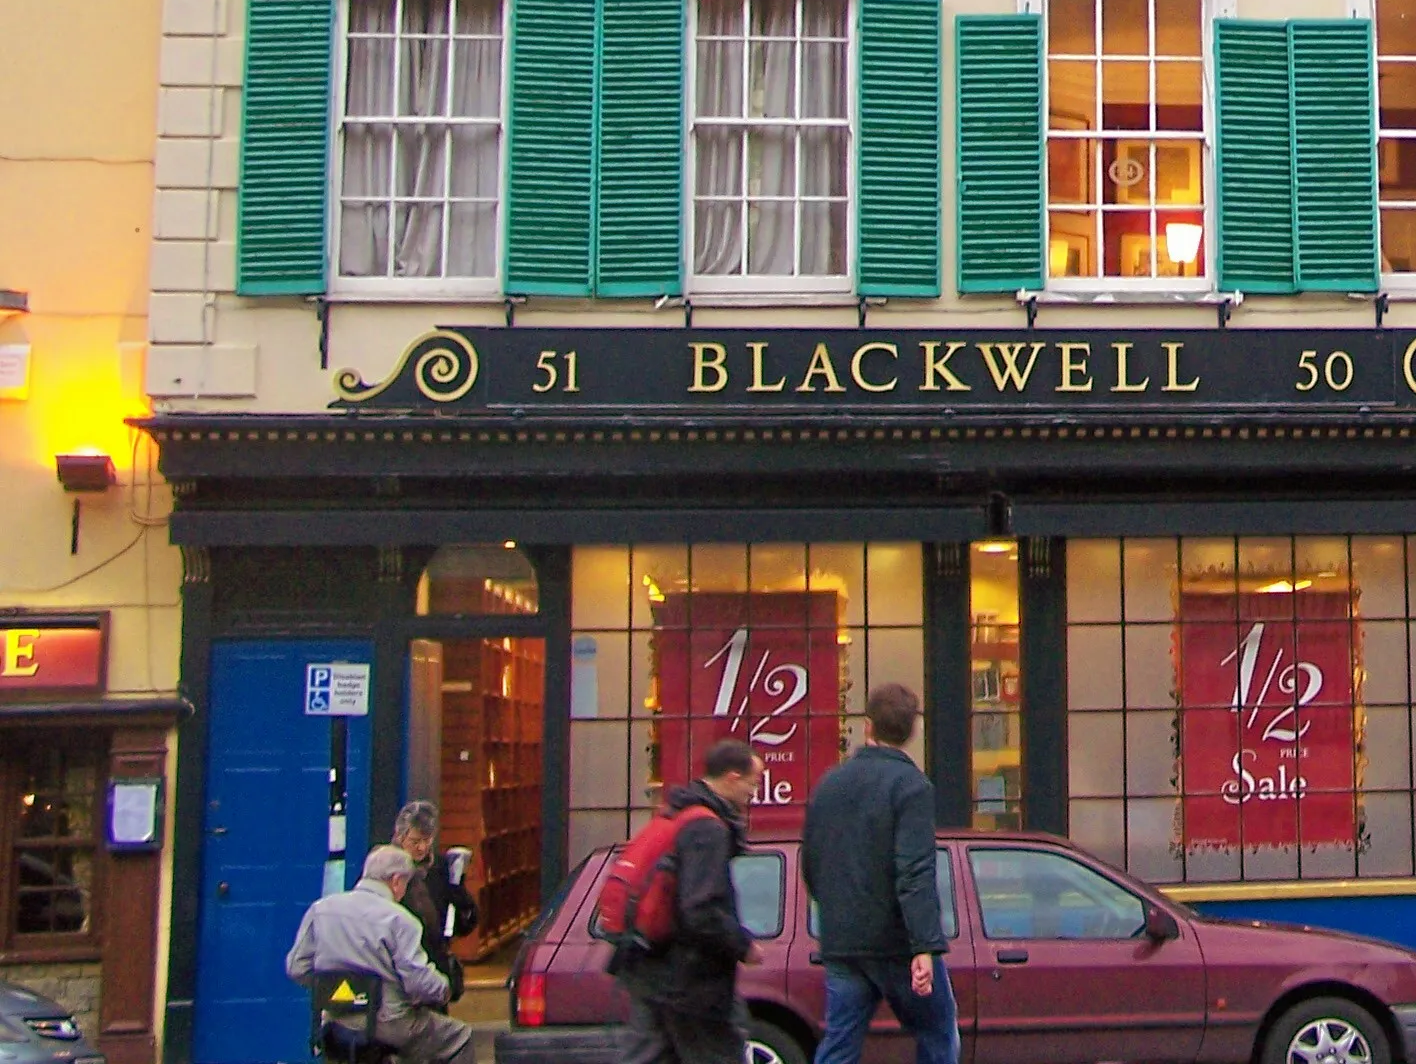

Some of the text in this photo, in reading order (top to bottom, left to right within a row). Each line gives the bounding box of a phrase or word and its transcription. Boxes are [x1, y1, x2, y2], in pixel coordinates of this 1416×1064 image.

[532, 341, 1355, 393] 51 BLACKWELL 50
[315, 669, 329, 686] P
[704, 625, 808, 745] 1/2
[1220, 622, 1324, 743] 1/2
[764, 751, 795, 762] PRICE
[1221, 748, 1308, 804] Sale
